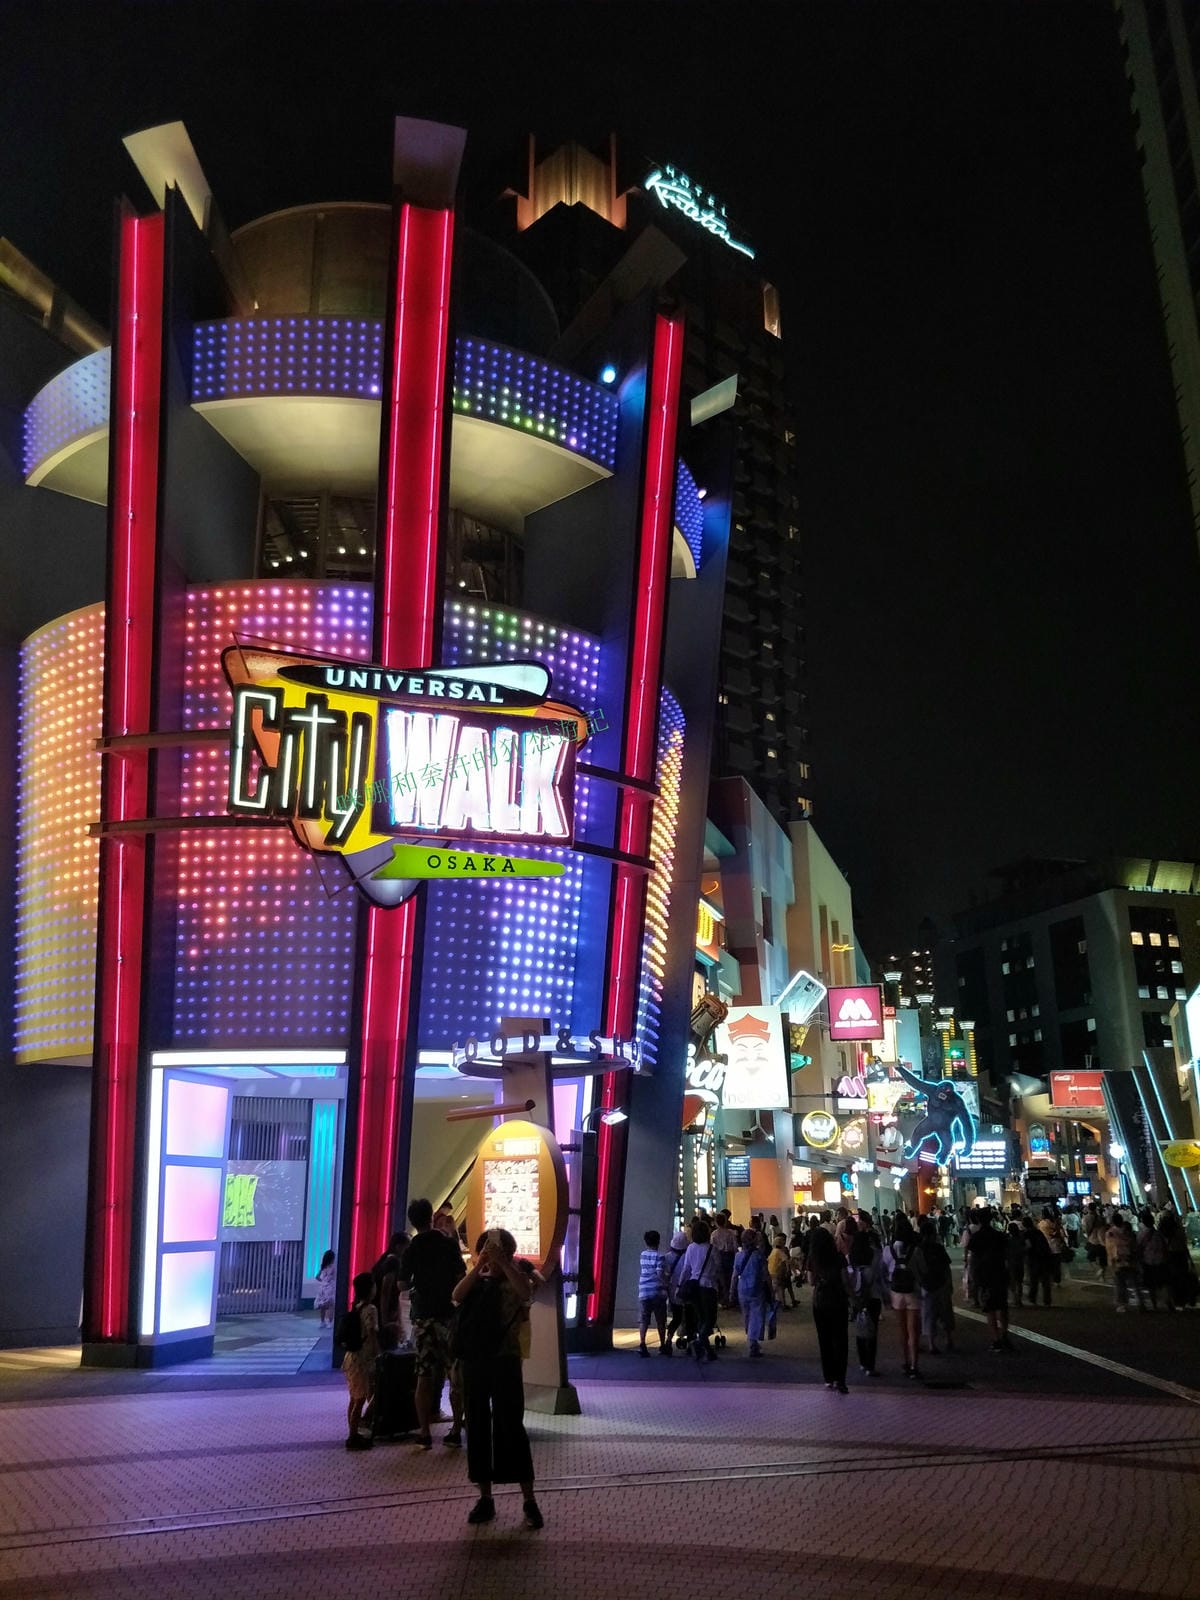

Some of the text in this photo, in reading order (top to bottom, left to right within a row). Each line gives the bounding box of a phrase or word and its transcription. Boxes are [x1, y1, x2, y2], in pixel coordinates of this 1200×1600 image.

[665, 164, 728, 218] HOTEL
[326, 667, 504, 705] UNIVERSAL
[231, 688, 572, 842] City WALK
[427, 854, 517, 874] OSAKA
